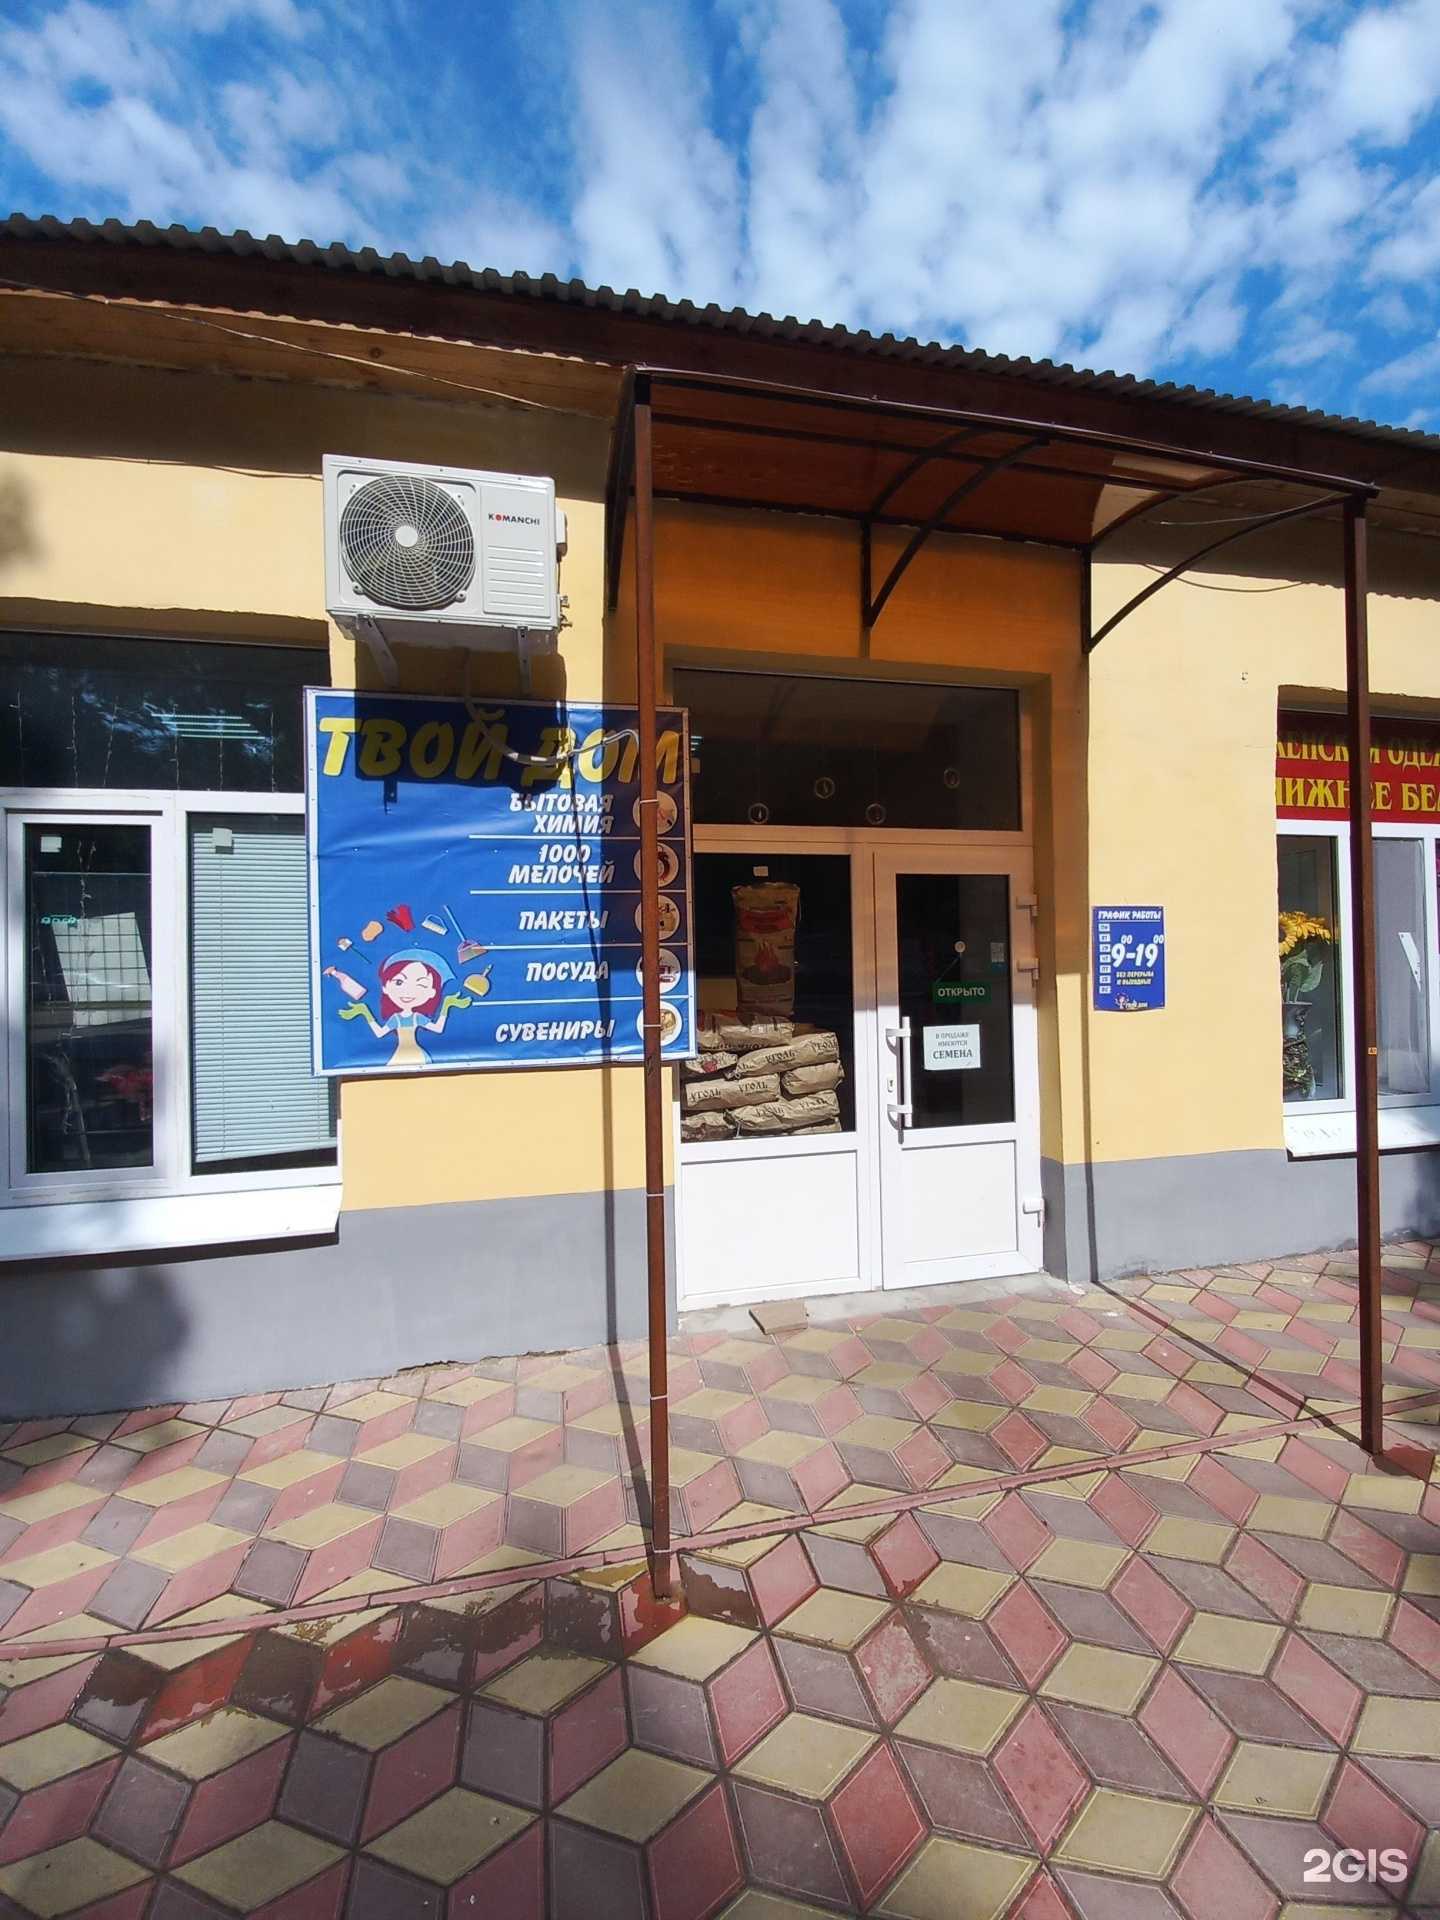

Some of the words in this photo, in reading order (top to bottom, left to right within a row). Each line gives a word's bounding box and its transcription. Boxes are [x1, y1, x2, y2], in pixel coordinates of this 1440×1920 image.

[488, 513, 541, 525] KOMANCHI
[319, 706, 509, 781] ТВОЙ
[520, 727, 680, 790] ДОМ
[509, 792, 614, 813] БЫТОВАЯ
[1401, 782, 1440, 812] БЕ
[533, 814, 615, 834] ХИМИЯ
[539, 844, 591, 864] 1000
[508, 860, 616, 885] МЕЛОЧЕЙ
[519, 911, 609, 931] ПАКЕТЫ
[1098, 910, 1131, 920] ГРАФИК
[1132, 910, 1162, 920] РАБОТЫ
[526, 961, 610, 983] ПОСУДА
[938, 987, 985, 997] ОТКРЫТО
[495, 1020, 615, 1043] СУВЕНИРЫ
[933, 1049, 973, 1060] СЕМЕНА
